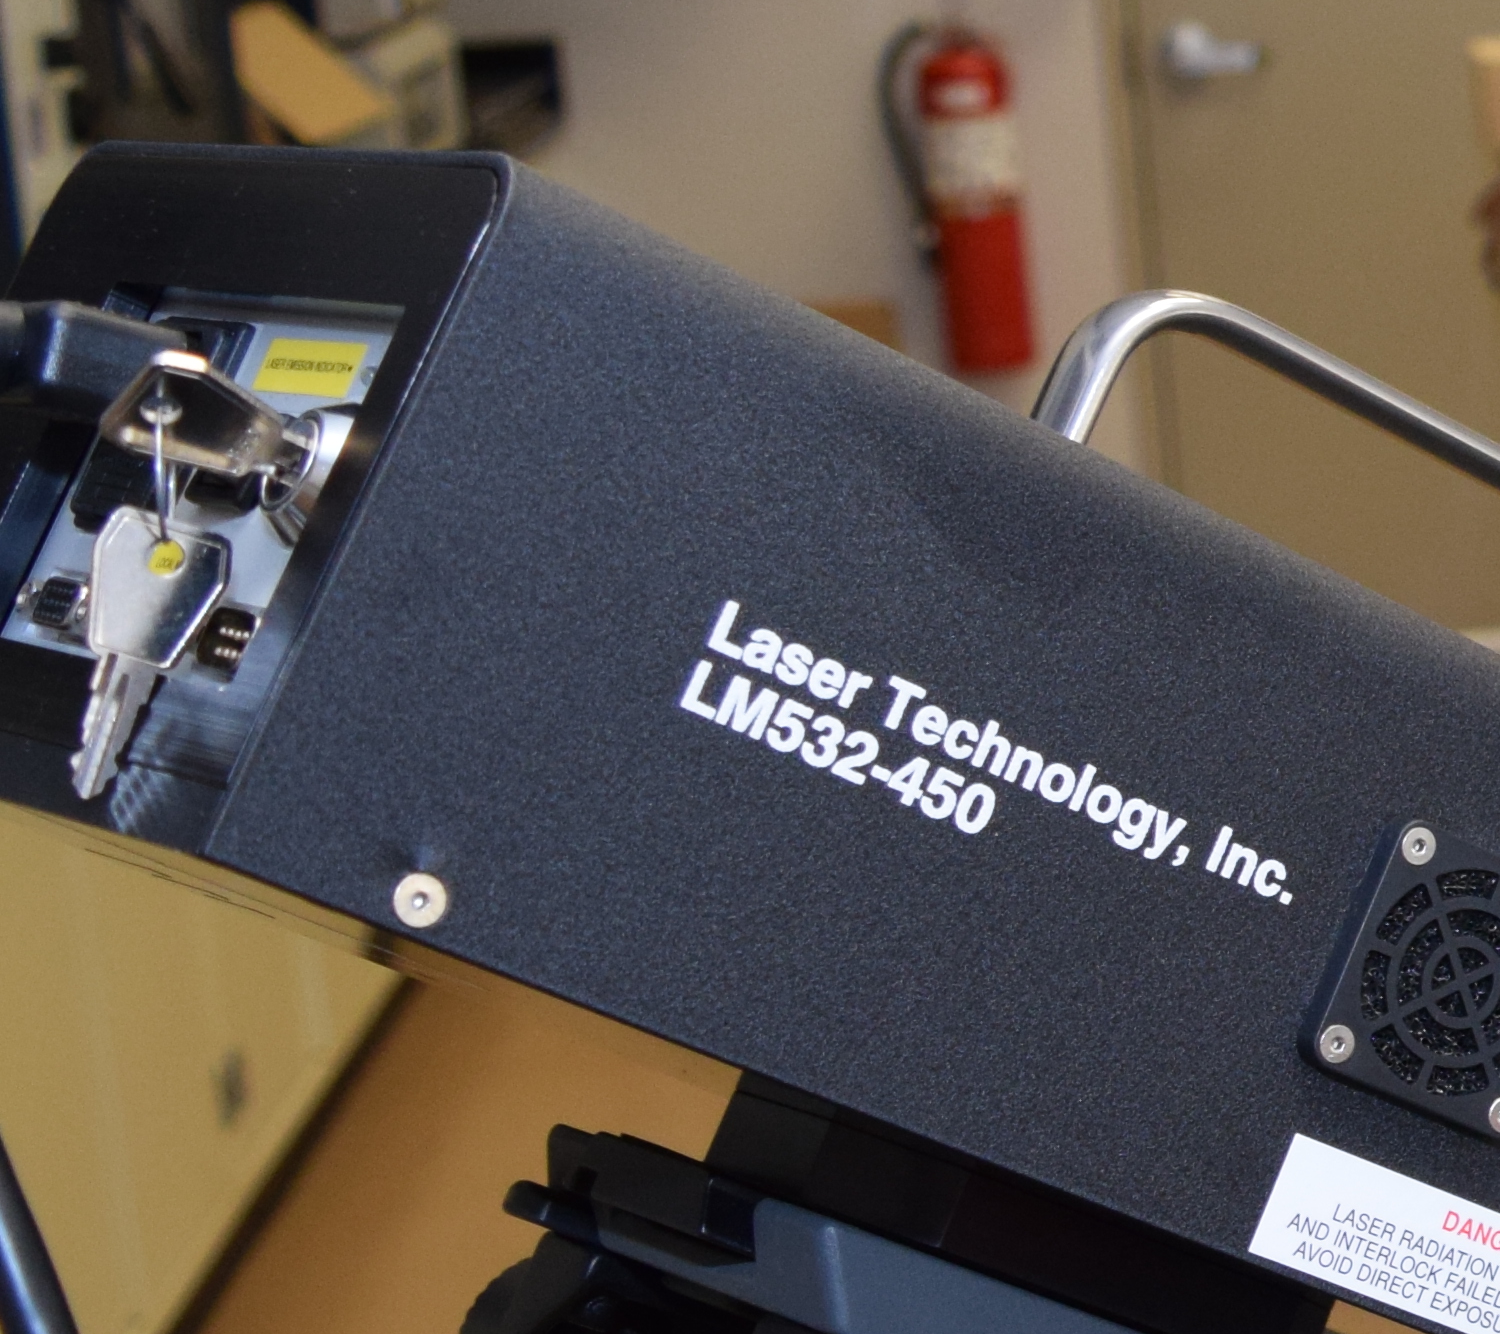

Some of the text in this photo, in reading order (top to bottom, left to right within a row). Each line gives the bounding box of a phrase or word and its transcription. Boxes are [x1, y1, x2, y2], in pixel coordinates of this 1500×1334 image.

[679, 661, 995, 836] LM532-450
[705, 600, 1293, 905] Laser Technology, Inc.
[1287, 1213, 1329, 1241] AND
[1333, 1230, 1439, 1283] INTERLOCK
[1293, 1241, 1353, 1277] AVOID
[1356, 1264, 1427, 1304] DIRECT
[1332, 1204, 1394, 1244] LASER
[1399, 1225, 1500, 1281] RADIATION
